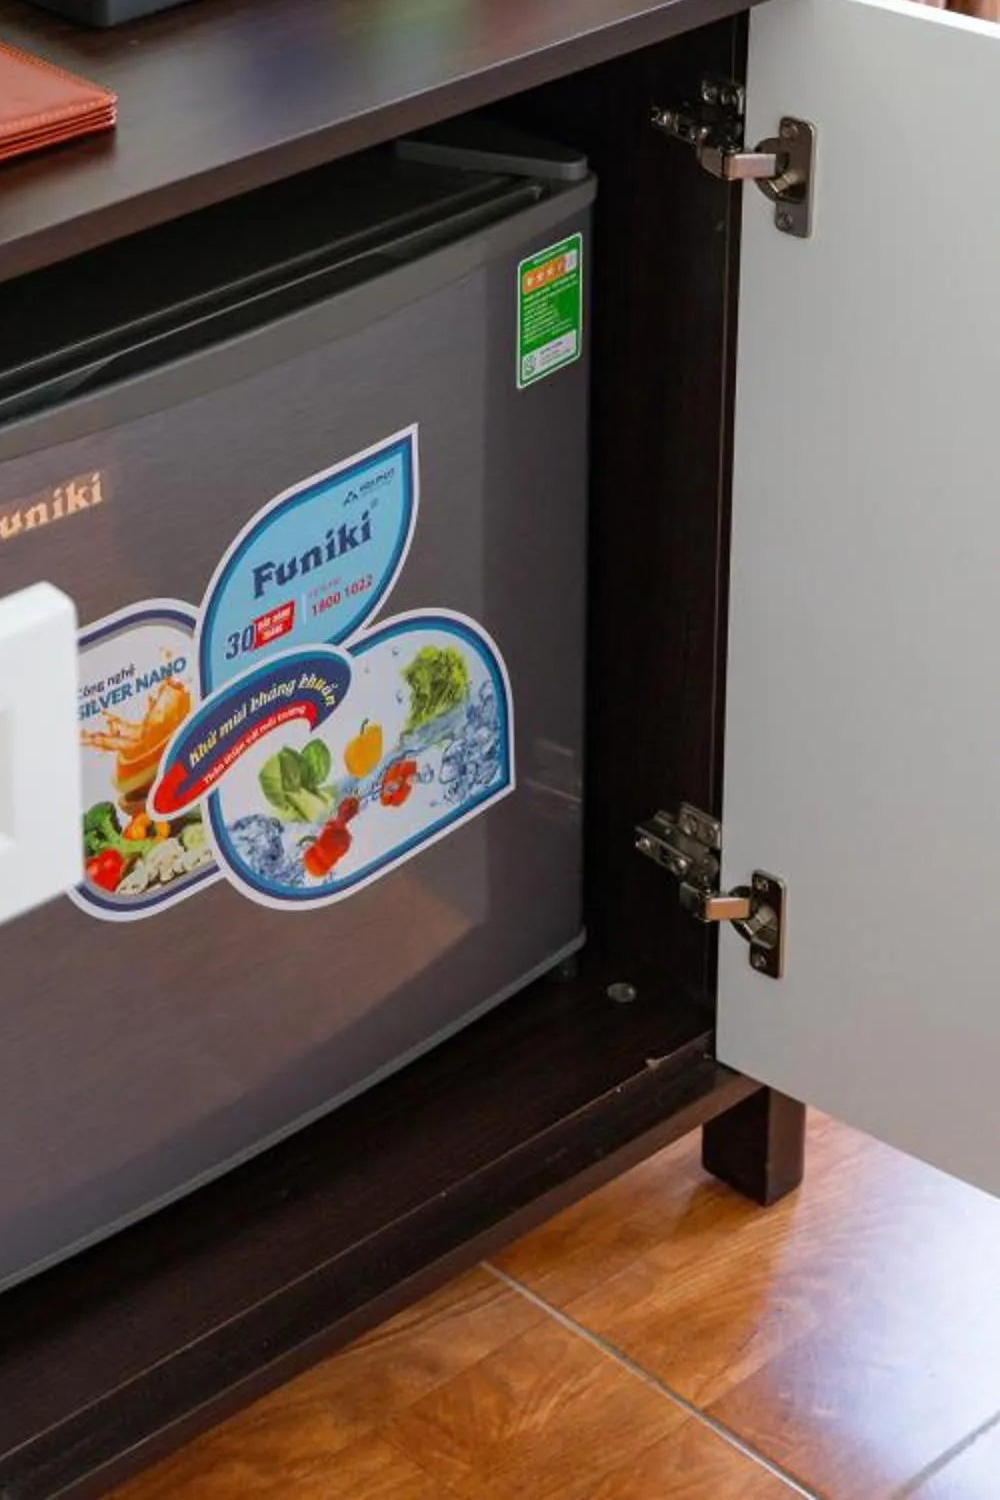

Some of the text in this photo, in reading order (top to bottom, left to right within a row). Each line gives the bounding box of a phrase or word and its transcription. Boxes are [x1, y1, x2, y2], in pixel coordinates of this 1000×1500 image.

[252, 509, 372, 599] Funiki
[225, 624, 255, 660] 30
[135, 656, 186, 693] NANO
